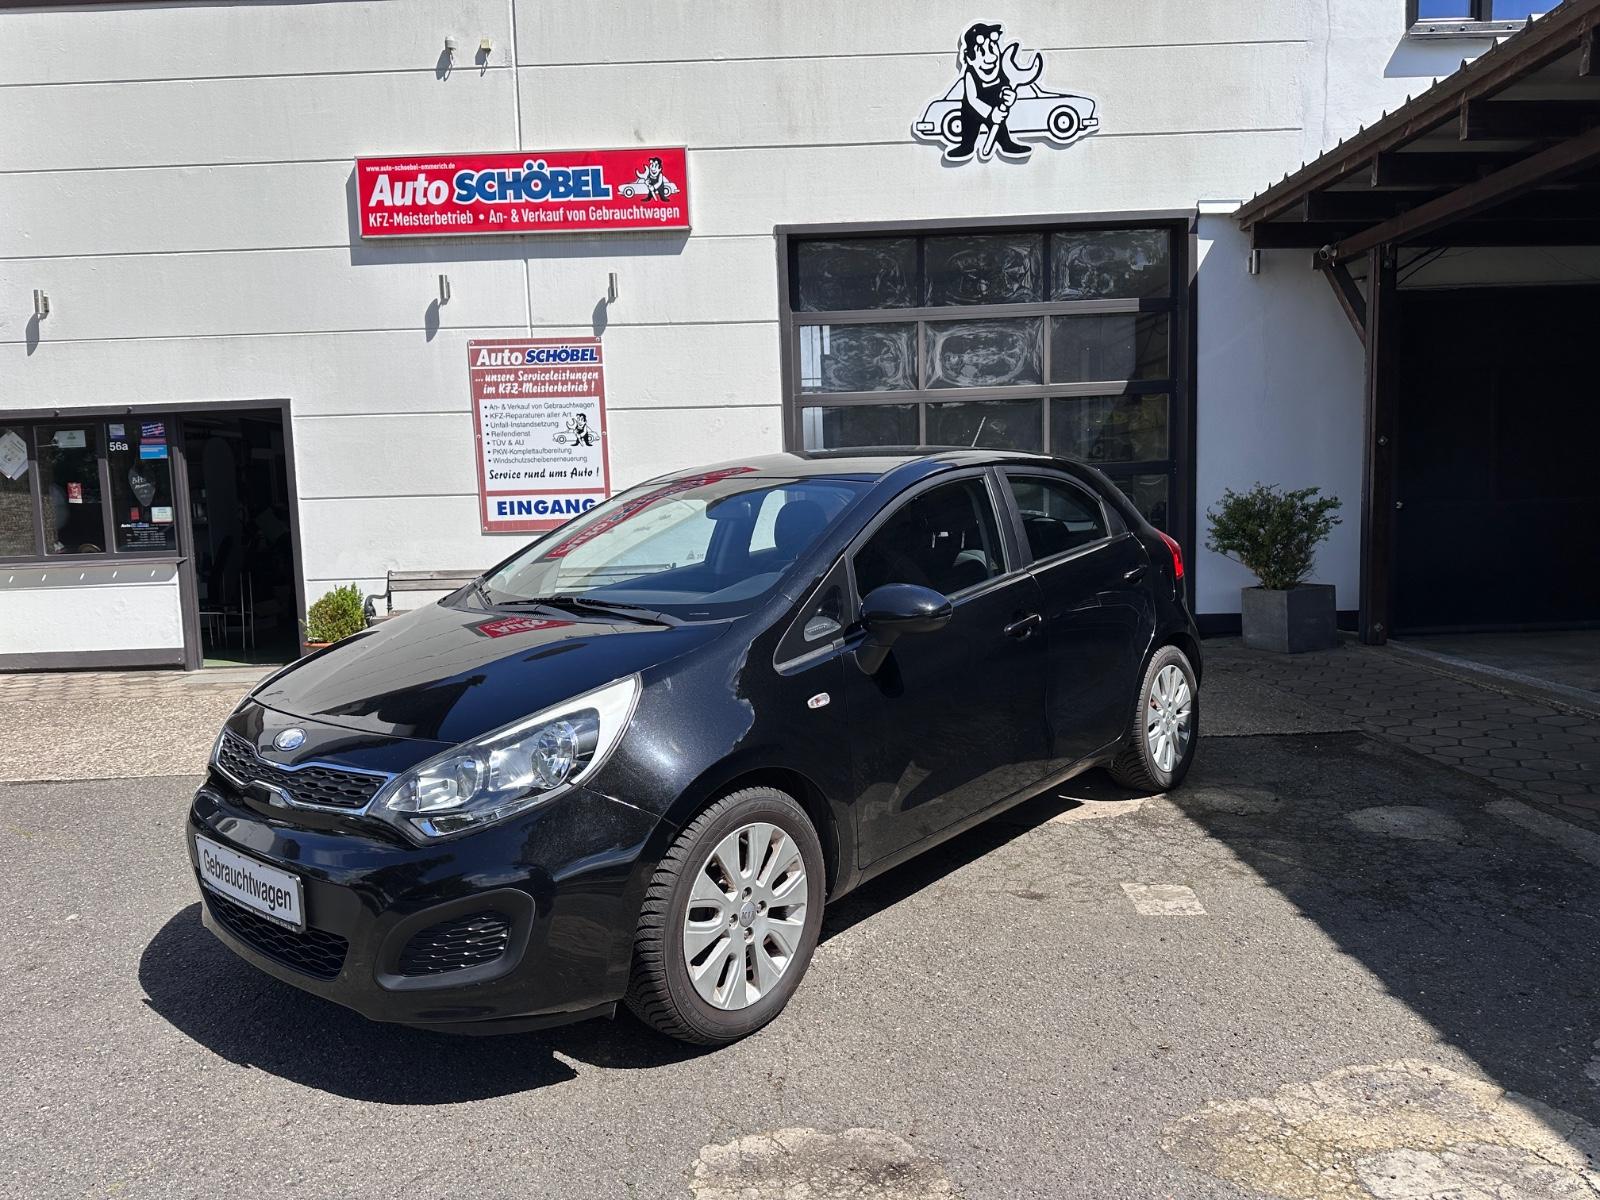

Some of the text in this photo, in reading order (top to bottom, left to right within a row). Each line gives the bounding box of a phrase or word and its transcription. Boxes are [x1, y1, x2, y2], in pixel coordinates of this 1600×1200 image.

[368, 160, 612, 207] Auto SCHÖBEL
[368, 205, 680, 227] KFZ-Meisterbetrieb An- & Verkauf von Gebrauchtwagen
[476, 345, 599, 366] Auto SCHÖBEL
[518, 370, 599, 383] Serviceleistungen
[483, 384, 496, 395] im
[498, 382, 588, 395] KFZ-Meisterbetrieb
[544, 402, 595, 411] Gebrauchtwagen
[489, 412, 545, 420] KFZ-Reparaturen
[109, 441, 129, 451] 56a
[492, 447, 572, 456] PKW-Komplettaufbereitung
[489, 469, 521, 480] Service
[524, 468, 546, 479] rund
[549, 470, 567, 478] ums
[570, 467, 593, 479] Auto
[497, 498, 597, 516] EINGANG
[203, 848, 292, 911] Gebrauchtwagen
